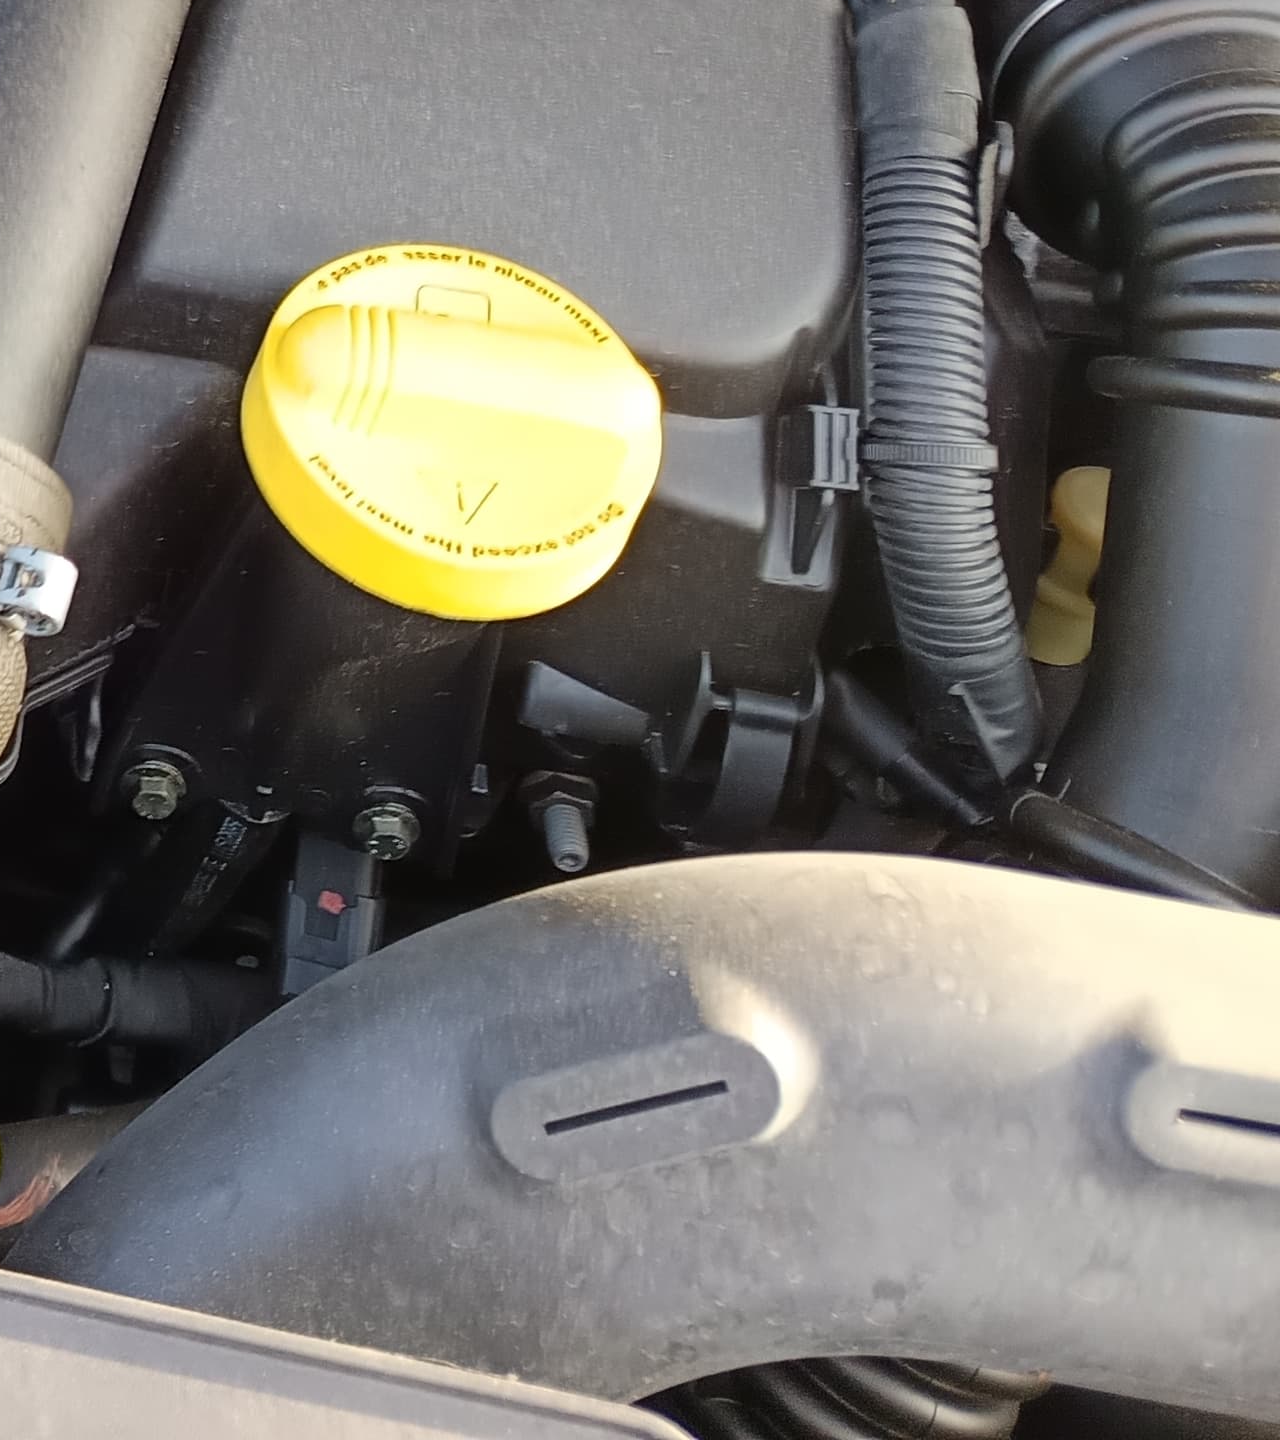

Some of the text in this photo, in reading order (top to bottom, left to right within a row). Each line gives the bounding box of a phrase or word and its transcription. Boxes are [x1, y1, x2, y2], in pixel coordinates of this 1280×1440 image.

[468, 255, 487, 269] le
[494, 264, 561, 304] niveau
[564, 303, 610, 344] maxi
[423, 535, 462, 555] the
[472, 540, 559, 558] exceed
